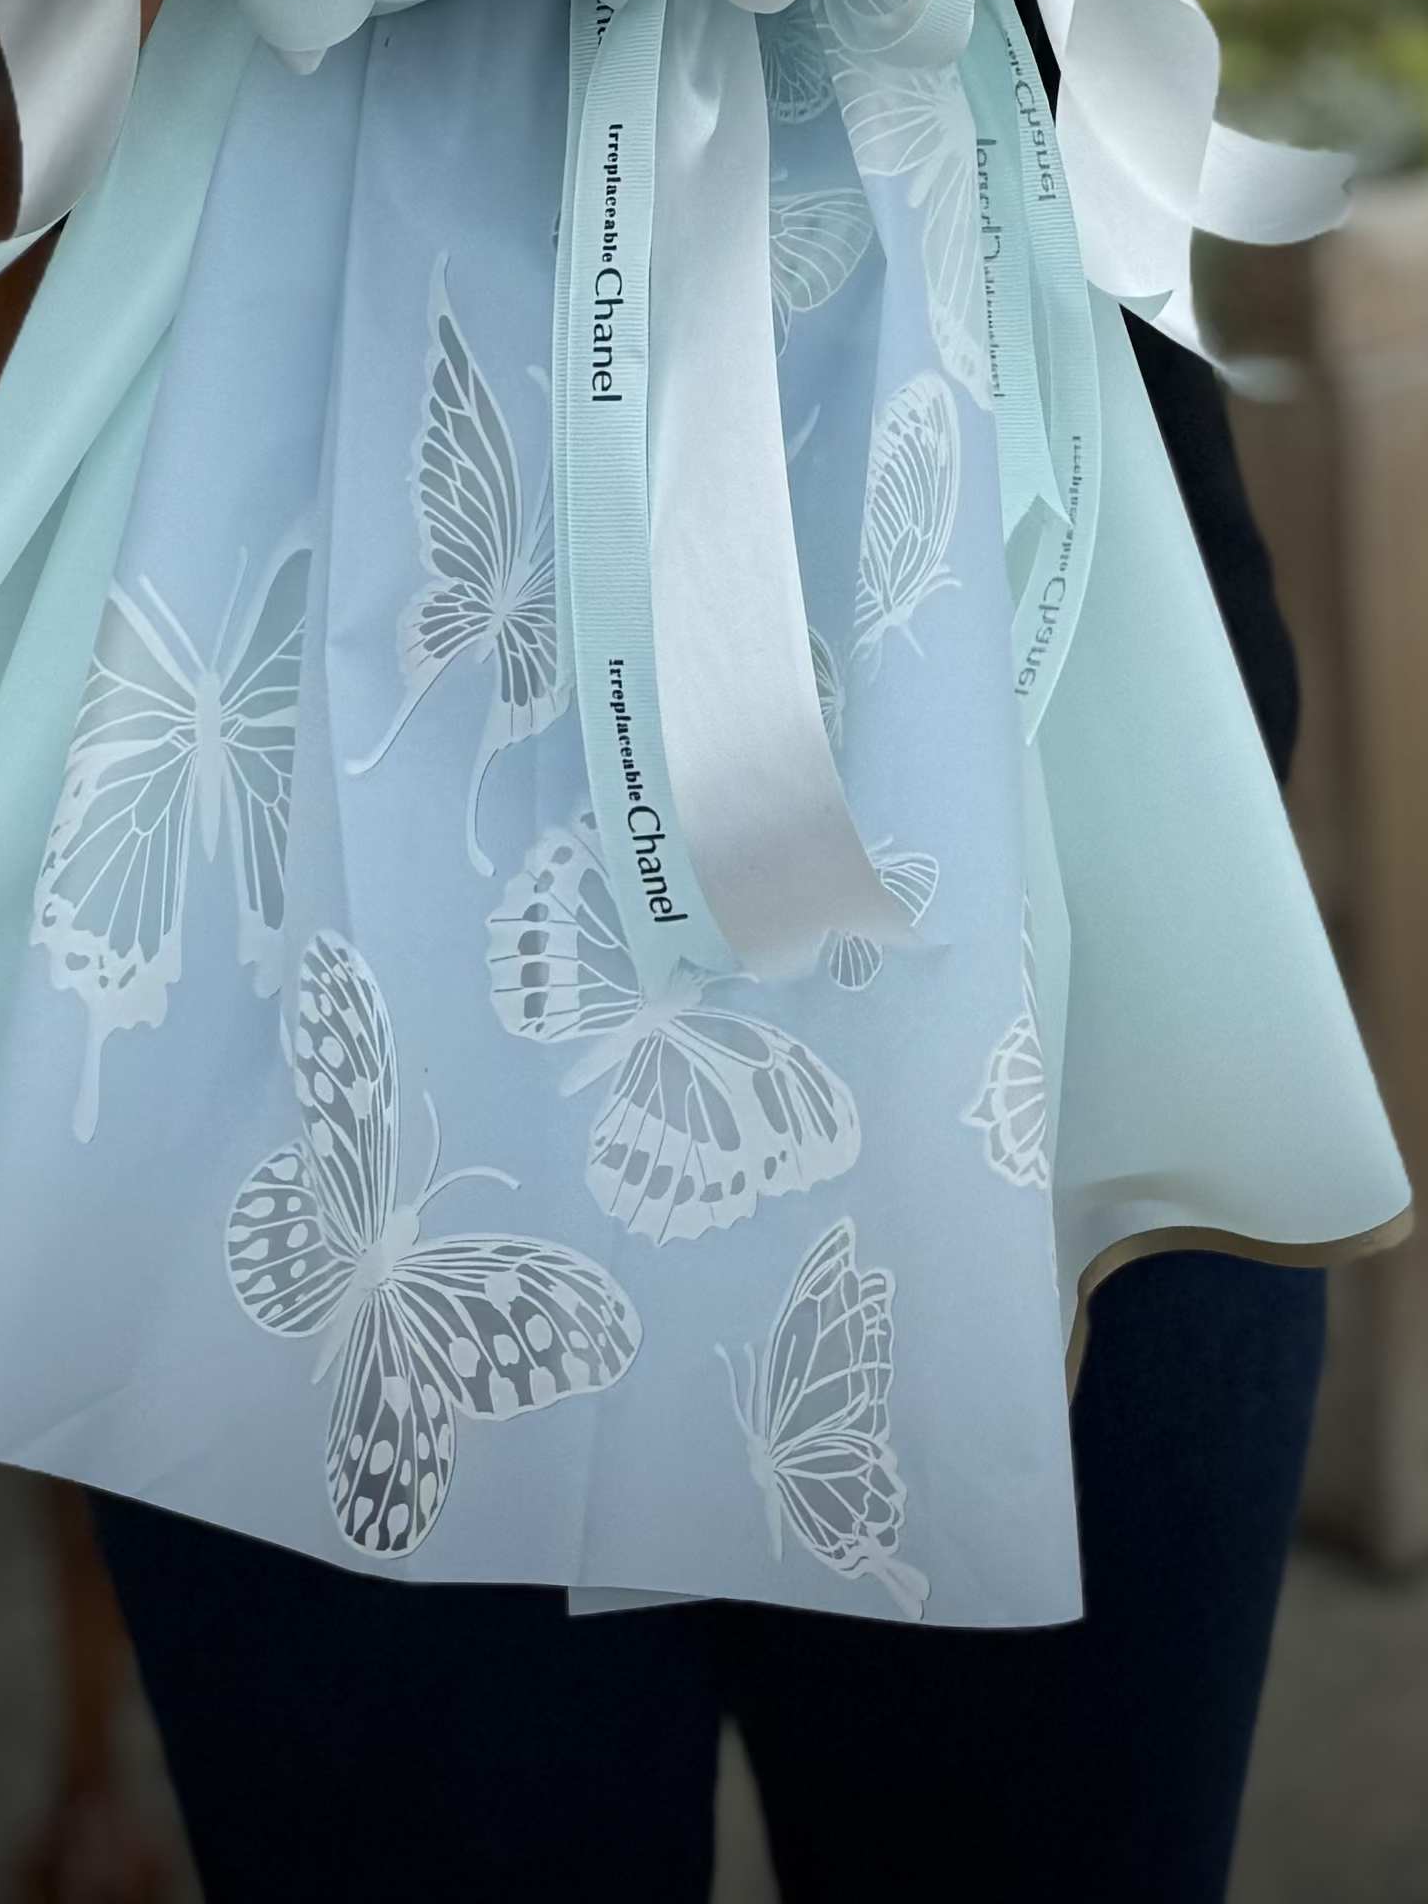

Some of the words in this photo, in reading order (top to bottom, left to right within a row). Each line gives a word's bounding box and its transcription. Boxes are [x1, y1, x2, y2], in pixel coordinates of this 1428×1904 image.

[602, 123, 624, 263] Irreplaceable
[591, 267, 624, 402] Chanel
[608, 659, 643, 801] Irreplaceable
[627, 805, 688, 922] Chanel
